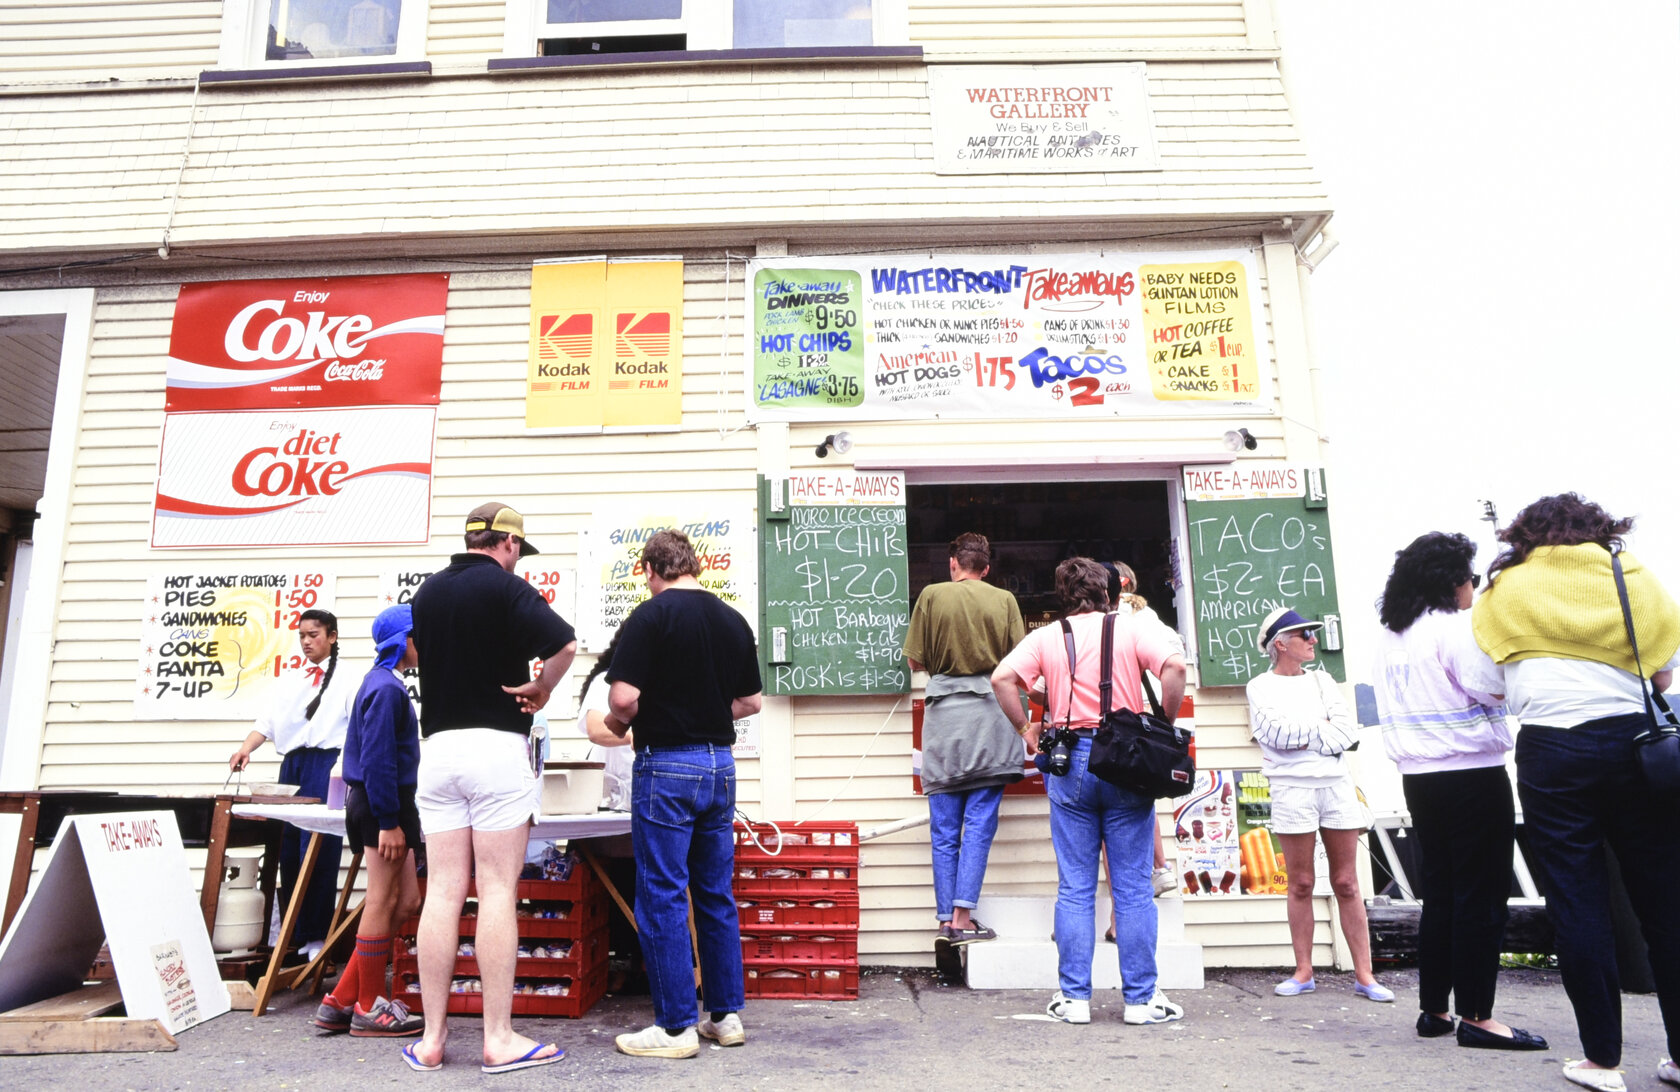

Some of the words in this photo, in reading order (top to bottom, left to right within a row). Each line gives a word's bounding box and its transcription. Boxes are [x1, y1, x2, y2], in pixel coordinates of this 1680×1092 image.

[966, 87, 1112, 103] WATERFRONT
[990, 103, 1090, 119] GALLERY
[996, 122, 1017, 132] We
[1020, 121, 1047, 134] Buy
[1065, 121, 1088, 132] Sell
[967, 135, 1040, 147] NAUTICAL
[969, 147, 1039, 159] MARITIME
[1043, 147, 1094, 159] WORKS
[1110, 147, 1139, 158] ART
[871, 265, 1028, 295] WATERFRONT
[1147, 273, 1184, 285] BABY
[1190, 272, 1237, 284] NEEDS
[293, 291, 330, 303] Enjoy
[1148, 287, 1197, 300] SUNTAN
[1200, 286, 1239, 299] LOTION
[767, 292, 850, 311] DINNERS
[910, 298, 947, 311] THESE
[1165, 301, 1226, 314] FILMS
[224, 299, 373, 362] Coke
[874, 319, 892, 329] HOT
[896, 318, 937, 329] CHICKEN
[940, 319, 951, 330] OR
[954, 319, 978, 330] MINCE
[981, 318, 999, 330] PIES
[1044, 319, 1067, 331] CANS
[1070, 319, 1079, 331] OF
[1081, 319, 1106, 331] DRINK
[1153, 324, 1183, 343] HOT
[1184, 317, 1234, 339] COFFEE
[761, 333, 794, 353] HOT
[799, 331, 852, 353] CHIPS
[877, 331, 901, 343] THICK
[934, 333, 990, 344] SANDWICHES
[1153, 350, 1168, 364] OR
[1172, 340, 1202, 360] TEA
[615, 361, 668, 375] Kodak
[877, 350, 958, 372] American
[538, 363, 591, 377] Kodak
[875, 369, 909, 387] HOT
[914, 365, 961, 382] DOGS
[1168, 365, 1210, 378] CAKE
[560, 381, 590, 391] FILM
[638, 379, 668, 389] FILM
[1105, 382, 1131, 393] each
[1170, 380, 1219, 392] SNACKS
[269, 420, 297, 432] Enjoy
[283, 429, 342, 456] diet
[232, 446, 349, 497] Coke
[789, 476, 900, 497] TAKE-A-AWAYS
[1186, 469, 1298, 491] TAKE-A-AWAYS
[776, 525, 830, 556] HOT
[164, 575, 194, 589] HOT
[196, 574, 239, 589] JACKET
[240, 573, 288, 588] POTATOES
[605, 582, 636, 591] DISPRIN
[1278, 562, 1325, 597] EA
[165, 590, 216, 607] PIES
[275, 589, 317, 609] 1.50
[604, 593, 648, 604] DISPOSABLE
[604, 605, 625, 616] BABY
[791, 607, 823, 630] HOT
[161, 611, 248, 627] SANDWICHES
[169, 628, 210, 640] CANS
[1208, 623, 1257, 656] HOT
[159, 641, 219, 658] COKE
[156, 660, 225, 678] FANTA
[156, 681, 214, 700] 7-UP
[1238, 772, 1270, 788] JUS
[101, 818, 163, 852] TAKE-AWAYS
